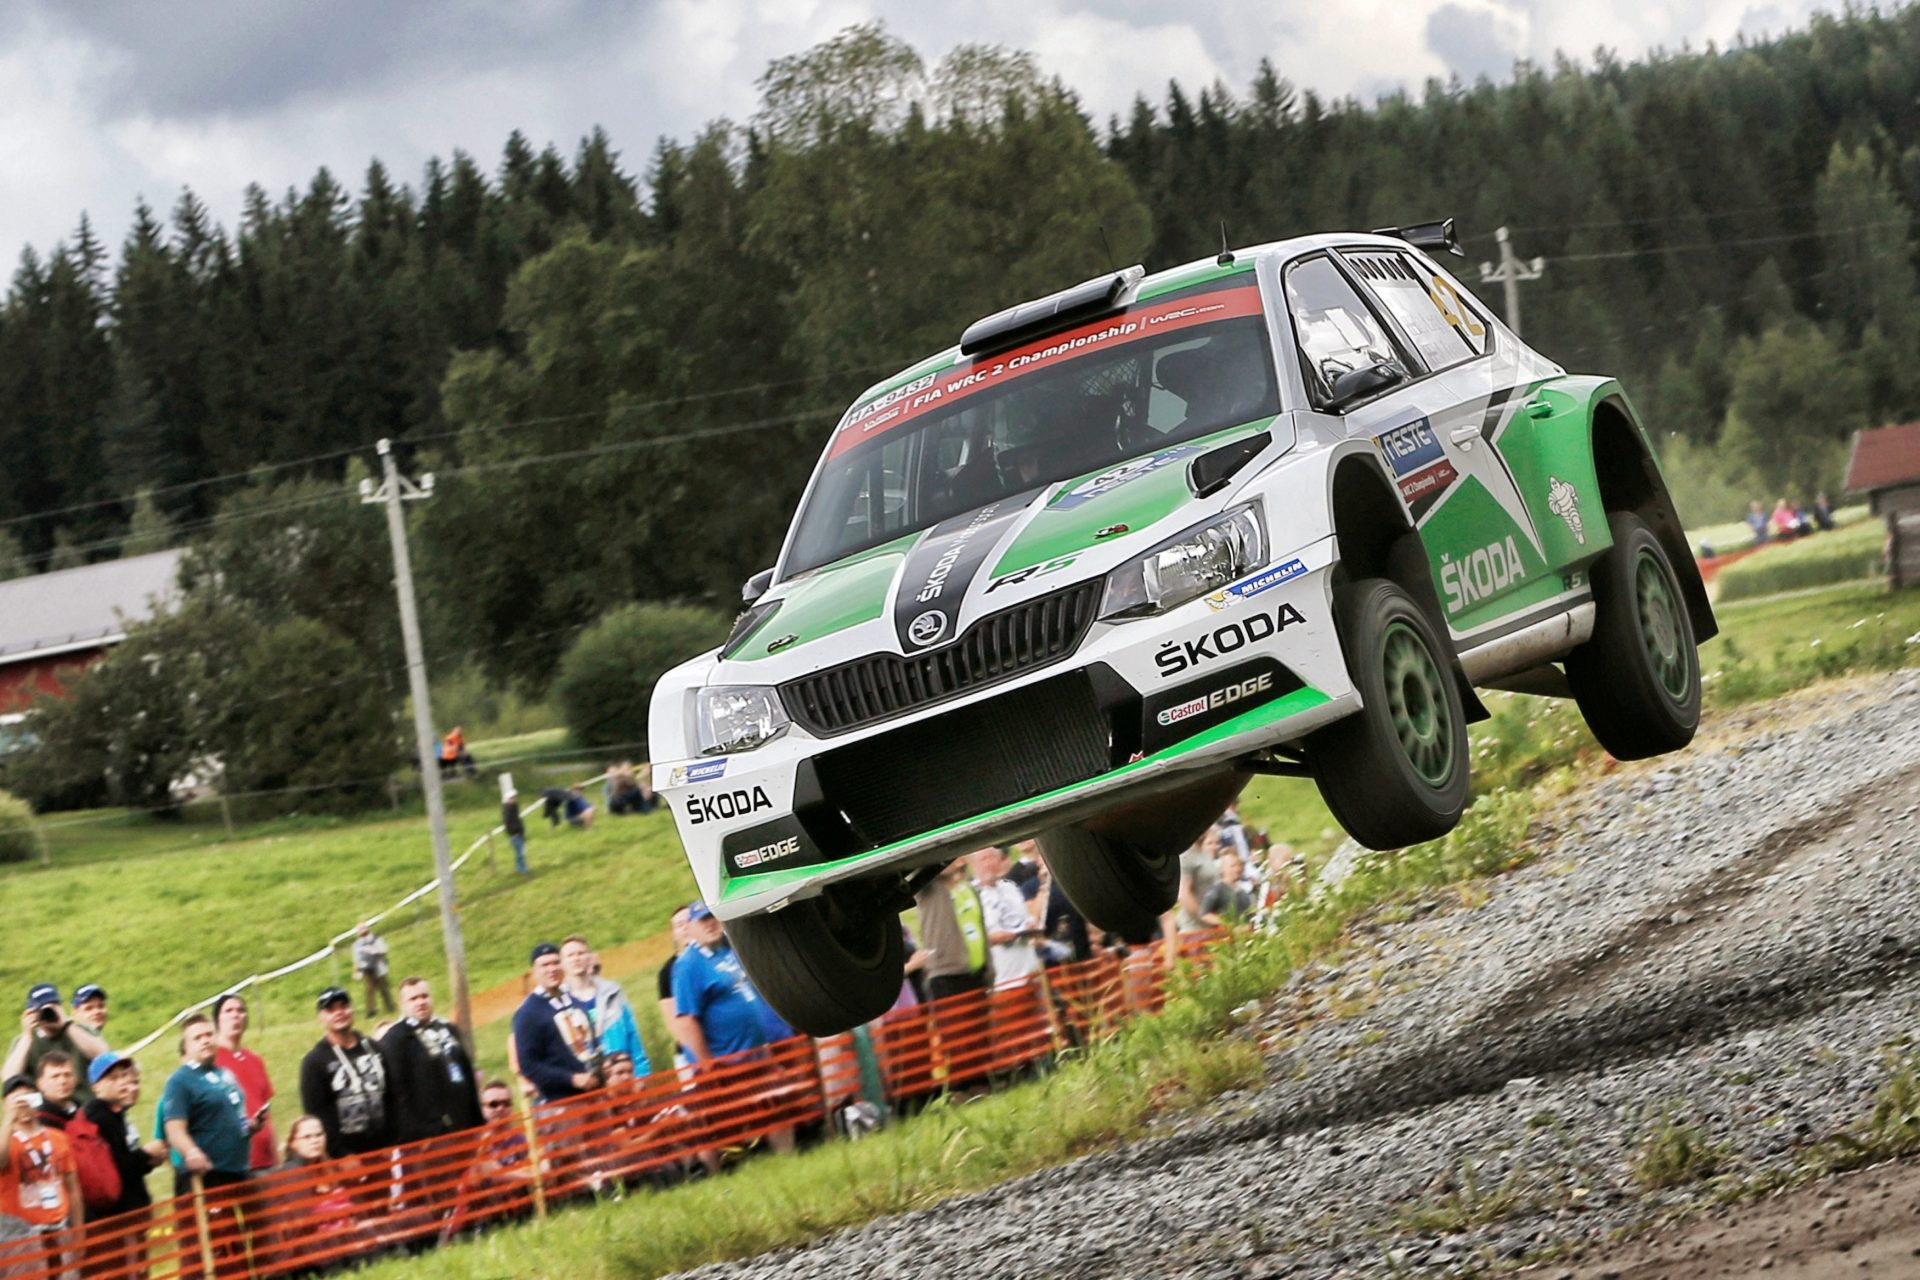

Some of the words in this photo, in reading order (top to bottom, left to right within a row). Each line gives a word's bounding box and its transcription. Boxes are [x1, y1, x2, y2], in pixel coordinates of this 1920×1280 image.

[913, 389, 942, 408] FIA
[947, 370, 987, 393] WRC
[991, 364, 1004, 375] 2
[1008, 322, 1137, 369] Championship
[915, 544, 966, 603] ŠKODA
[983, 552, 1086, 595] R5
[1241, 561, 1303, 594] MICHELIN
[1440, 535, 1526, 613] ŠKODA
[1154, 602, 1307, 678] ŠKODA
[1170, 698, 1206, 721] Castrol
[1209, 671, 1274, 709] EDGE
[686, 785, 773, 825] ŠKODA
[760, 835, 800, 863] EDGE
